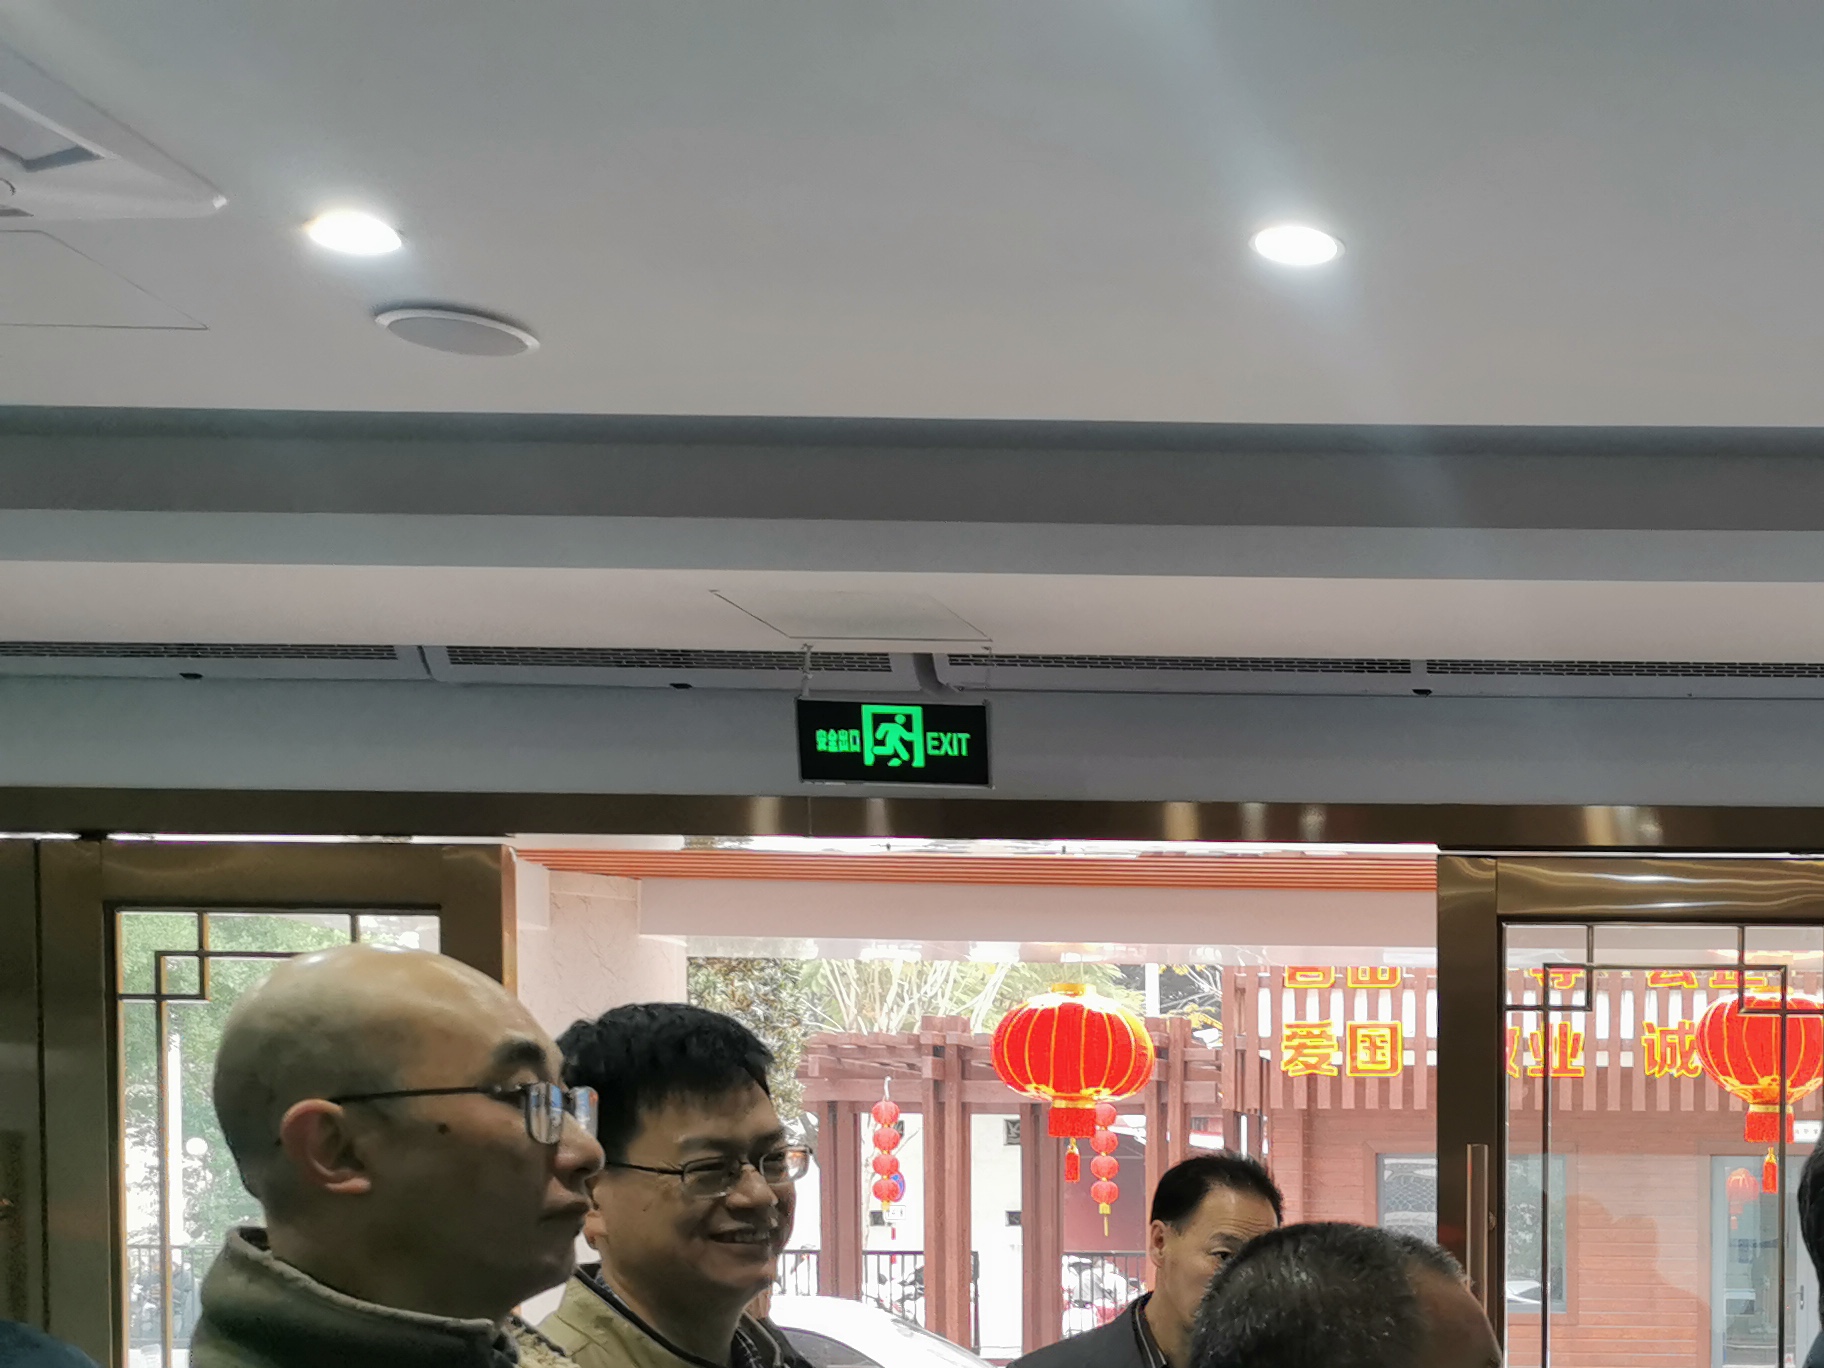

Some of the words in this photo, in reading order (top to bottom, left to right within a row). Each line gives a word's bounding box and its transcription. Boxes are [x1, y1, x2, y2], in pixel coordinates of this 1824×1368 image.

[815, 729, 861, 753] 安全出口
[926, 731, 971, 757] EXIT
[1280, 1019, 1403, 1077] 爱国
